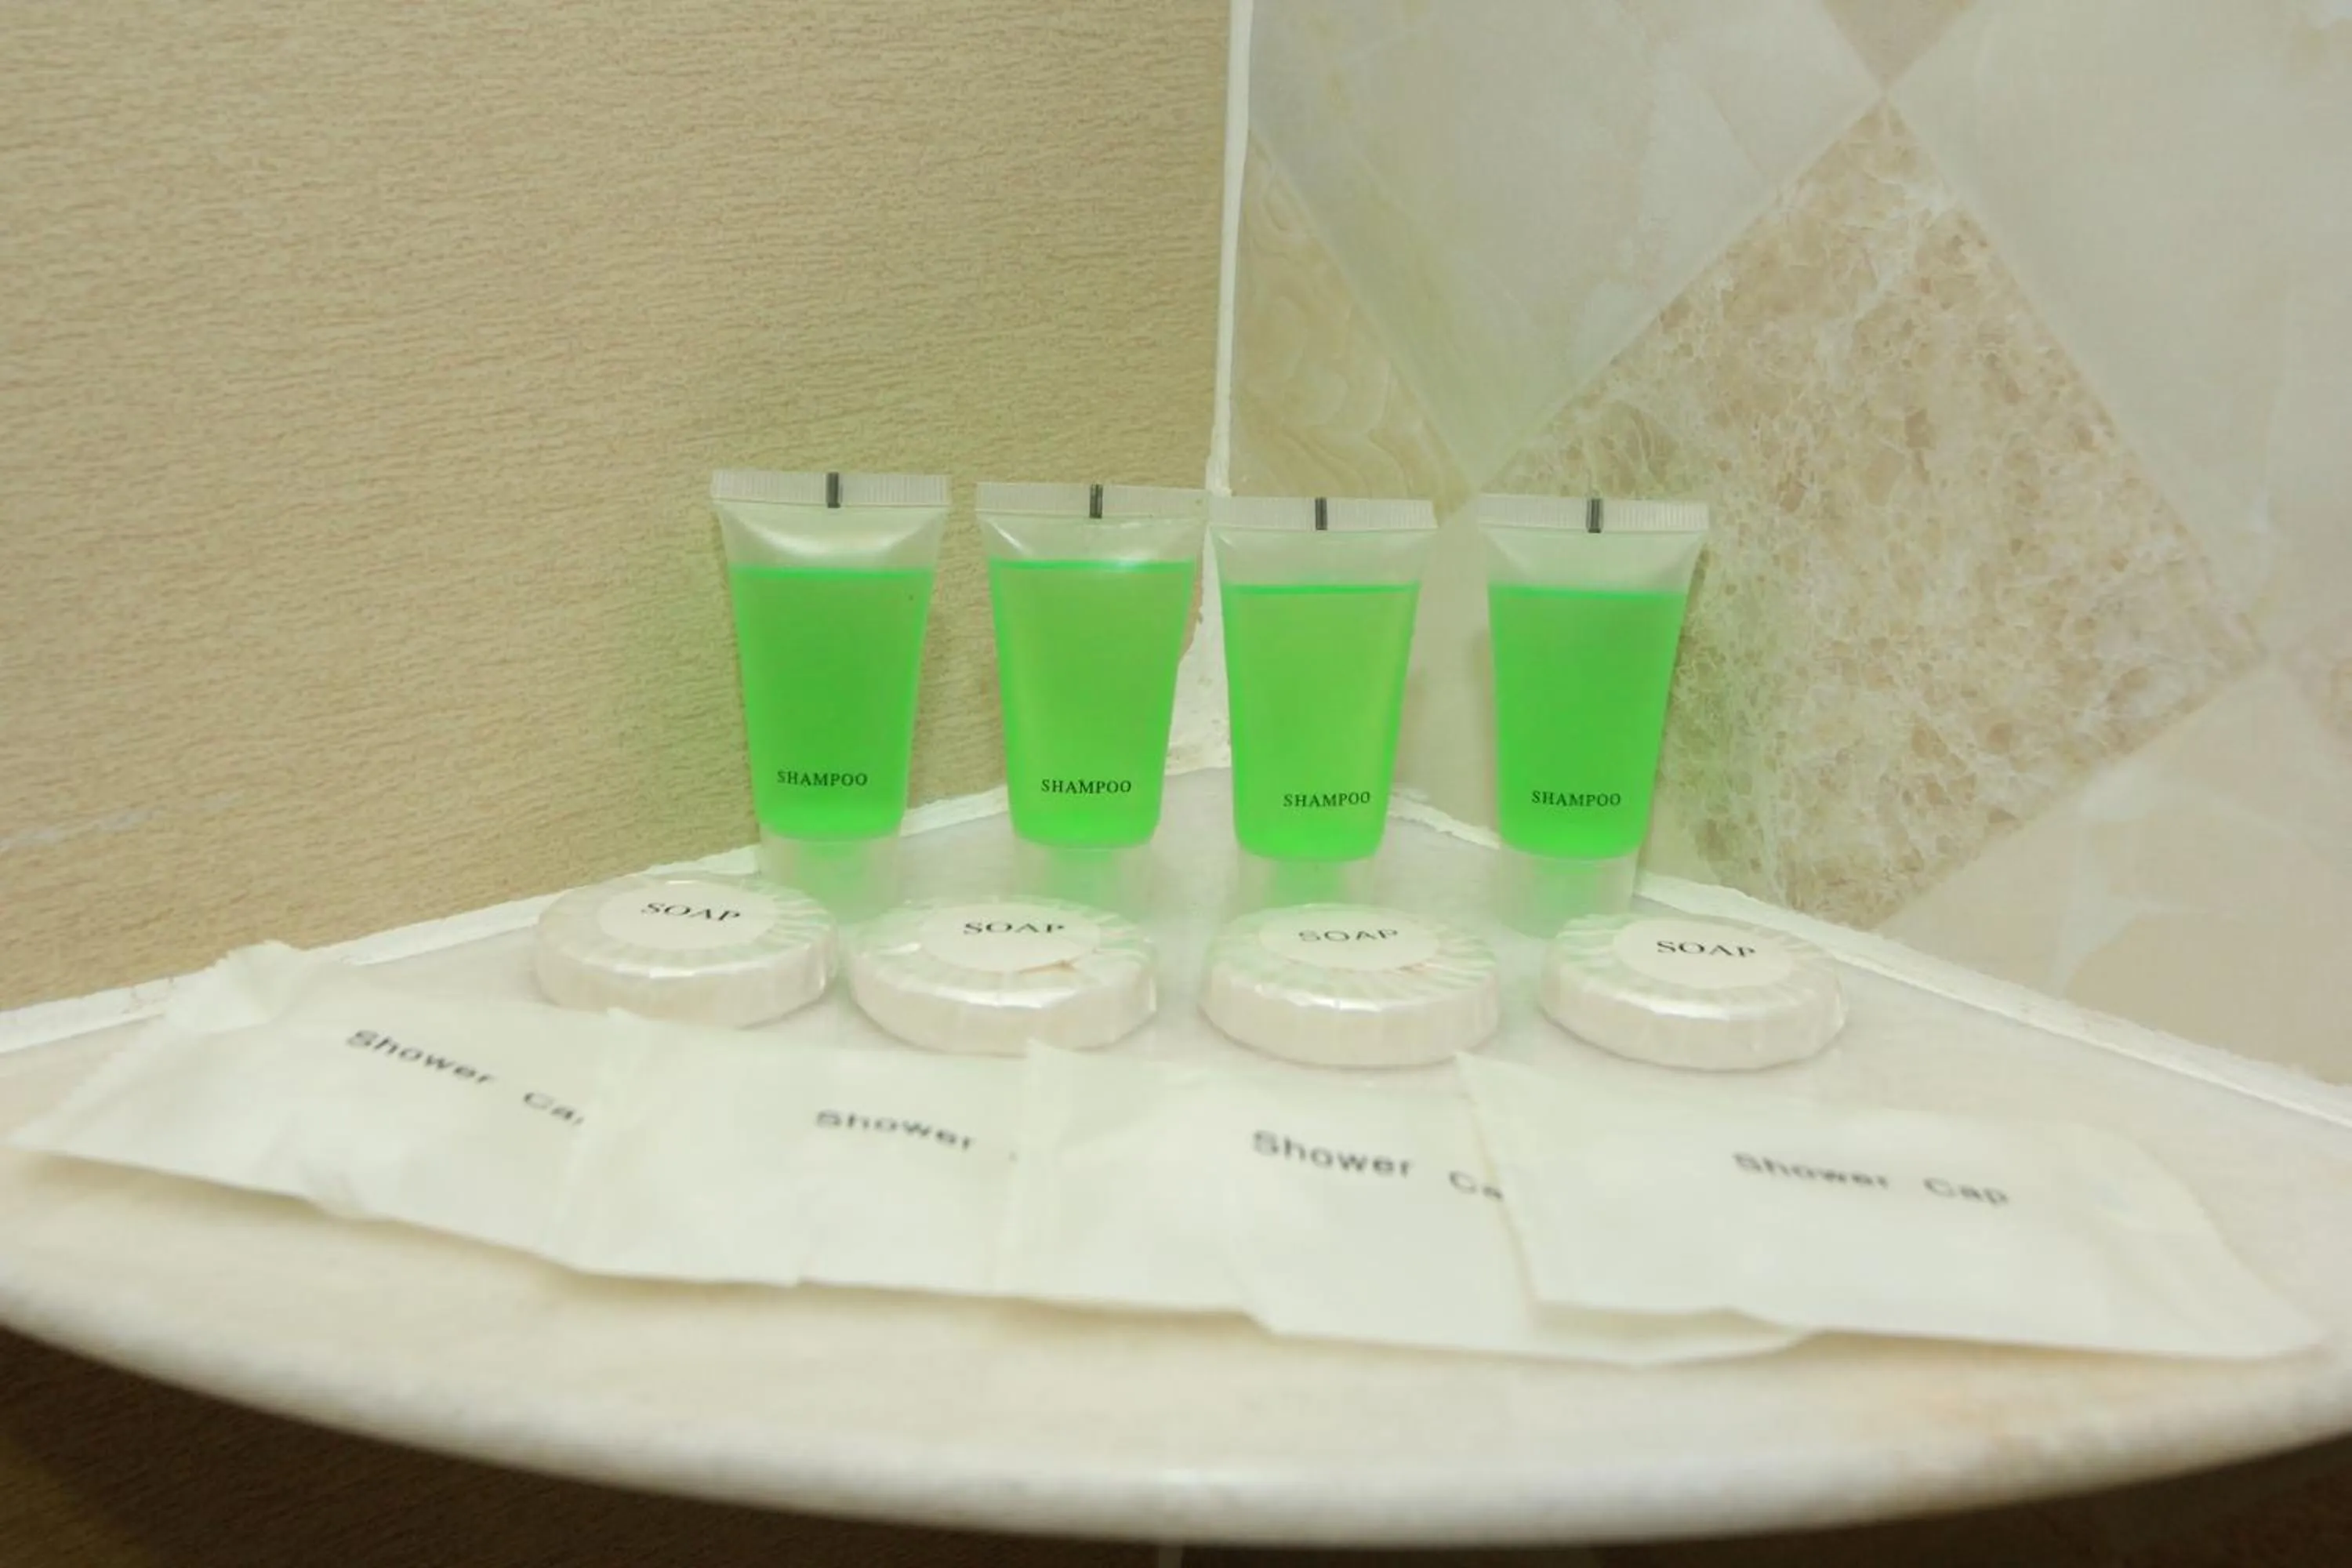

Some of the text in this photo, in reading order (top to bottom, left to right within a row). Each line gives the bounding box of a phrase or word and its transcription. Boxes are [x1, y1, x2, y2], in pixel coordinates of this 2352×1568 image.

[777, 770, 868, 787] SHAMPOO
[1040, 779, 1132, 795] SHAMPOO
[1283, 791, 1371, 808] SHAMPOO
[1531, 790, 1621, 808] SHAMPOO
[641, 901, 742, 923] SOAP
[963, 919, 1065, 937] SOAP
[1298, 928, 1399, 943] SOAP
[1656, 939, 1756, 958] SOAP
[346, 1029, 495, 1084] Shower
[815, 1109, 974, 1152] Shower
[1252, 1129, 1412, 1178] Shower
[1922, 1177, 2010, 1207] Cap
